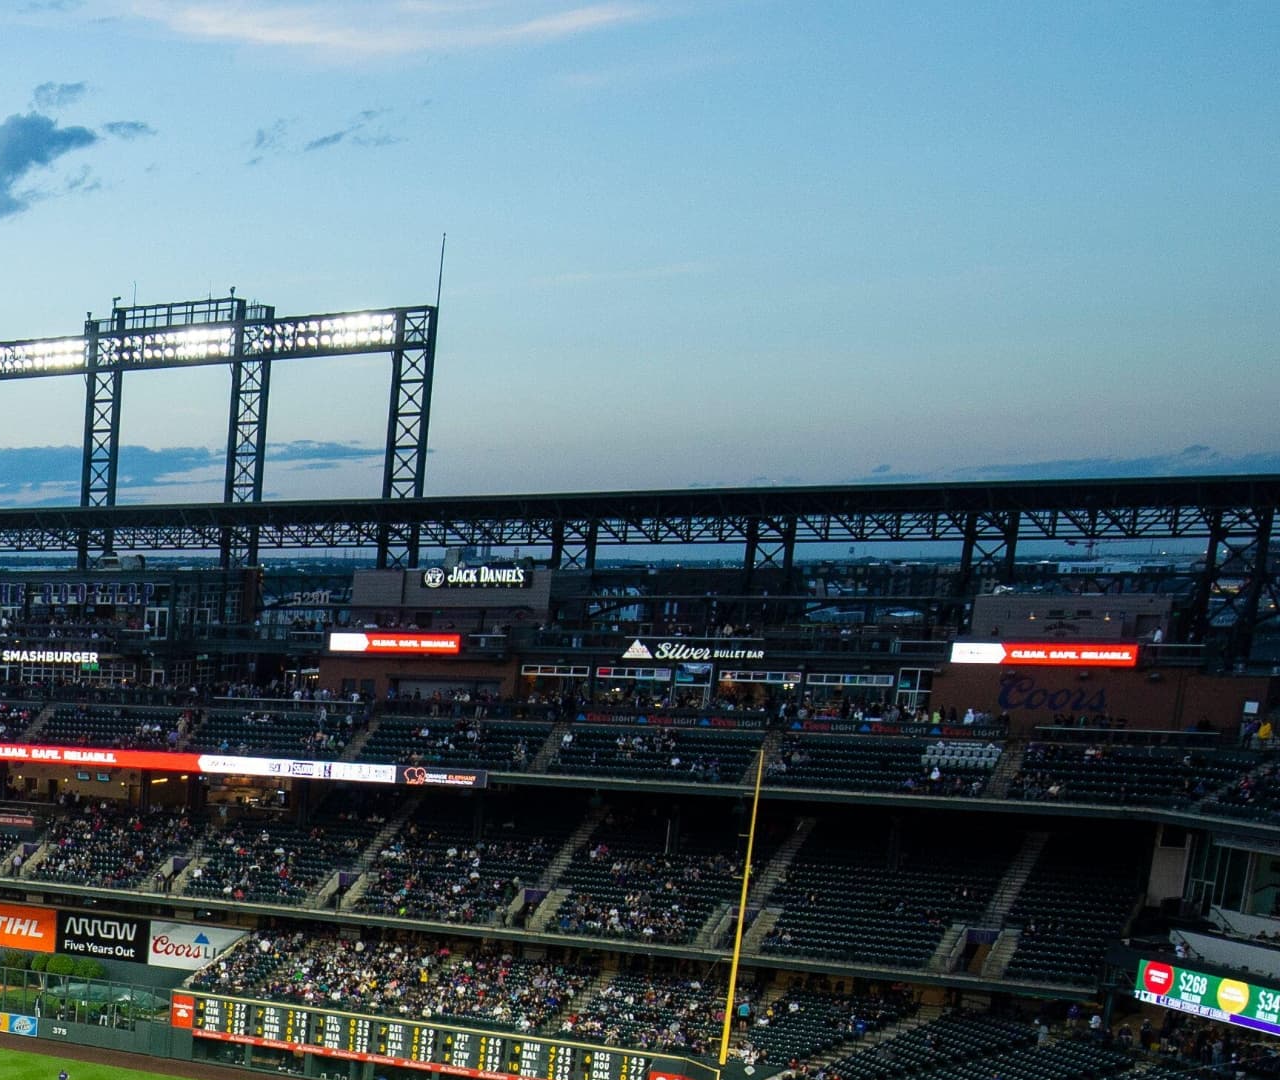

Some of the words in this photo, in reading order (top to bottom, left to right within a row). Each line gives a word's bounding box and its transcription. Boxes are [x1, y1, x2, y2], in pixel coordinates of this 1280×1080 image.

[448, 566, 477, 583] JACK
[480, 566, 525, 583] DANIEL'S
[293, 591, 331, 605] 5280
[2, 650, 99, 663] SMASHBURGER
[655, 643, 711, 661] Silver
[714, 650, 746, 658] BULLET
[747, 650, 764, 659] BAR
[998, 673, 1107, 713] Coors
[673, 717, 697, 725] LIGHT
[738, 720, 762, 728] LIGHT
[831, 723, 857, 732] LIGHT
[900, 726, 928, 735] LIGHT
[972, 728, 1001, 737] LIGHT
[32, 748, 61, 759] SAFE.
[65, 916, 137, 941] ARROW
[64, 940, 85, 952] Five
[86, 942, 114, 957] Years
[115, 944, 136, 958] Out
[152, 934, 202, 959] Coors
[1179, 971, 1208, 995] $268
[52, 1027, 67, 1036] 375
[457, 1033, 469, 1042] PIT
[388, 1042, 402, 1050] LAA
[454, 1042, 464, 1050] KC
[523, 1042, 540, 1052] MIN
[594, 1061, 609, 1071] HOU
[593, 1071, 609, 1080] OAK
